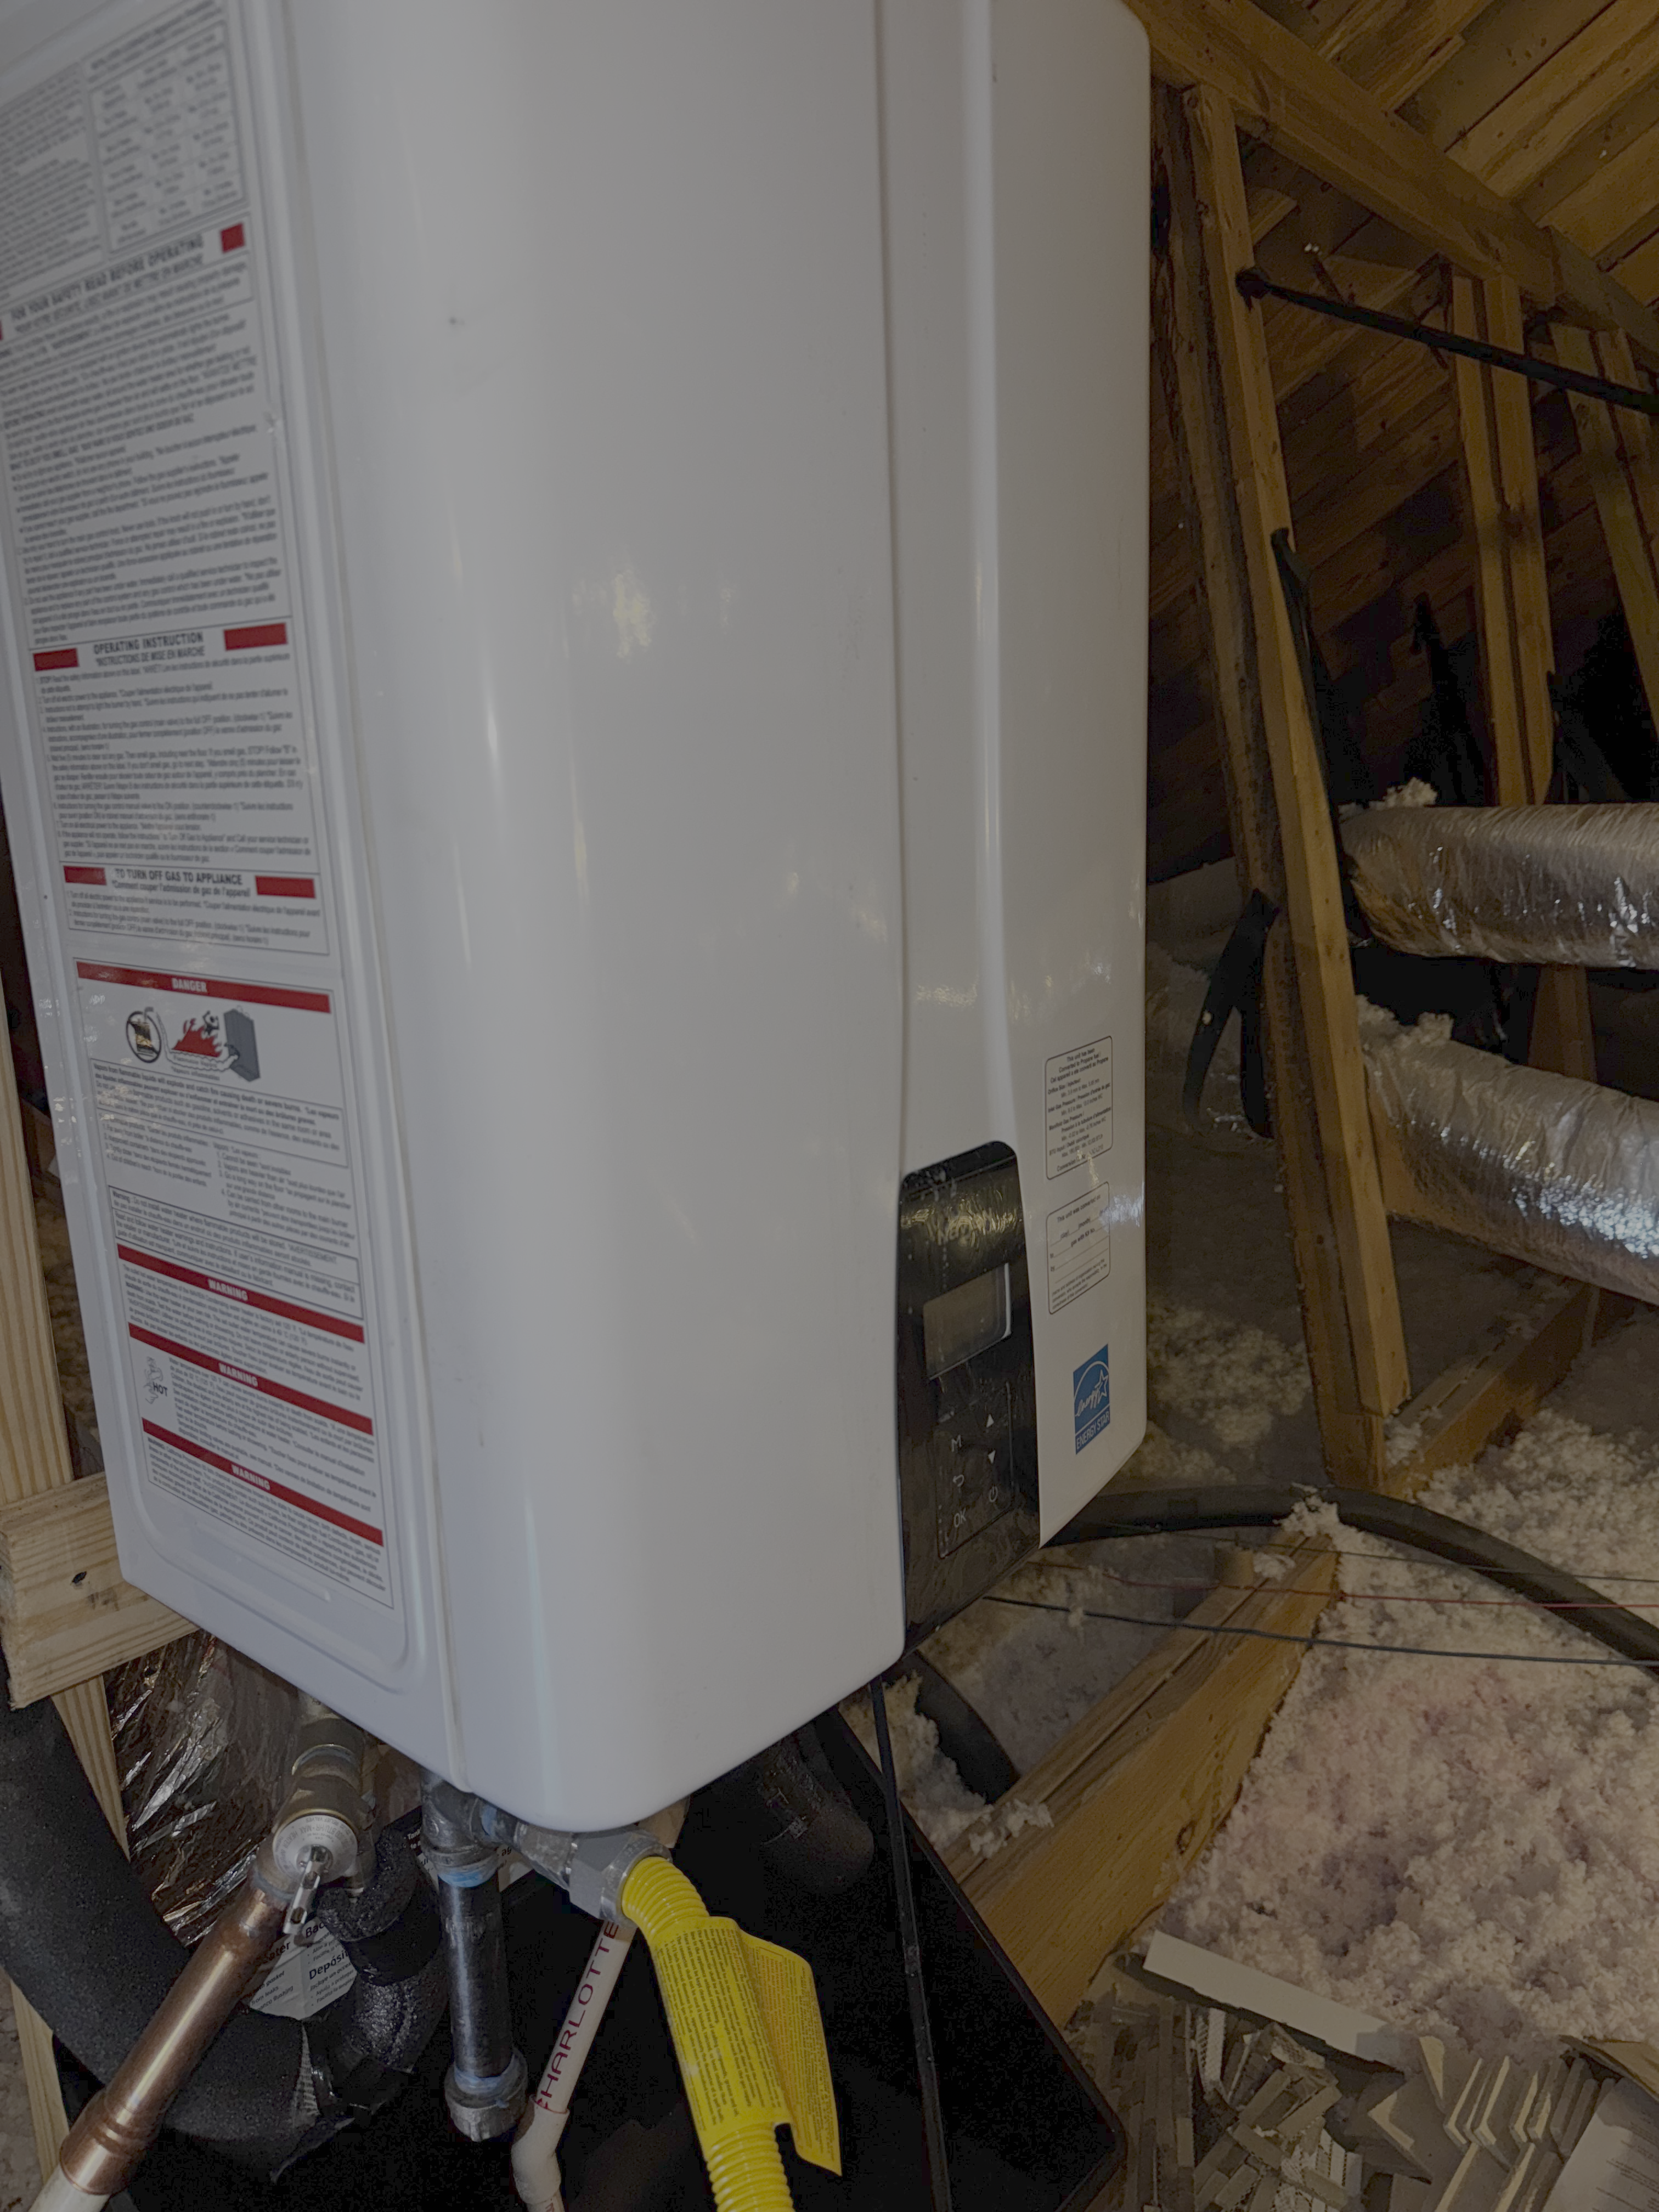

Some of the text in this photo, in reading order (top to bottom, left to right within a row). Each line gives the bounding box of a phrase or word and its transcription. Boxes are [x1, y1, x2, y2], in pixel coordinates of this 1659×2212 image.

[93, 631, 203, 654] OPERATING INSTRUCTION
[115, 868, 242, 885] TO TURN OFF GAS TO APPLIANCE
[171, 977, 207, 993] DANGER
[207, 1278, 249, 1302] WARNING
[218, 1362, 258, 1387] WARNING
[152, 1381, 168, 1397] HOT
[1076, 1410, 1109, 1449] ENERGY STAR
[951, 1434, 962, 1452] M
[231, 1464, 270, 1491] WARNING
[953, 1508, 966, 1527] OK
[299, 1824, 312, 1835] MAX
[266, 1970, 285, 1987] gasket
[264, 1985, 279, 1997] leaks
[273, 1985, 294, 2001] flushing
